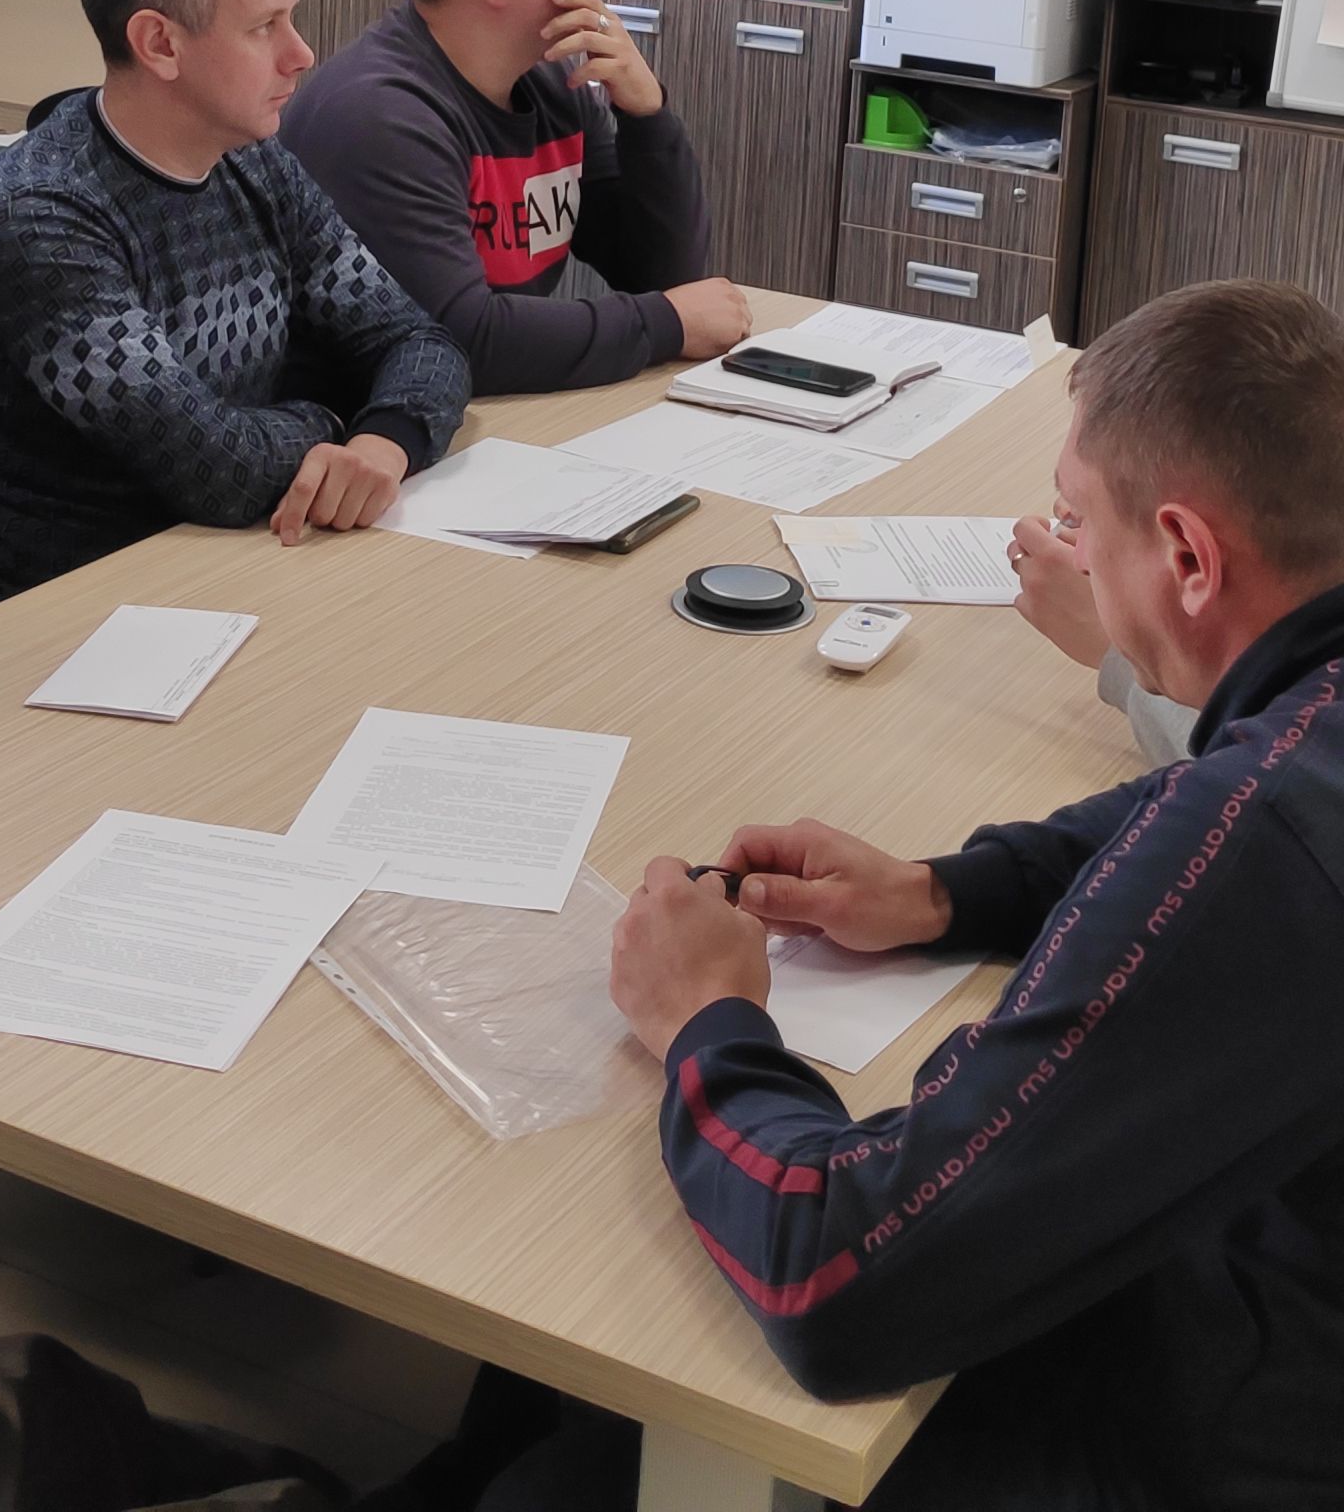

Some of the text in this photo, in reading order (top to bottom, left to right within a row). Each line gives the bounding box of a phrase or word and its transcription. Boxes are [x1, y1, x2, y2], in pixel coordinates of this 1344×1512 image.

[1085, 858, 1117, 899] sw
[1147, 776, 1258, 935] maraton sw
[1017, 942, 1145, 1103] maraton sw
[827, 1143, 872, 1172] sw
[863, 1106, 1013, 1254] maraton sw
